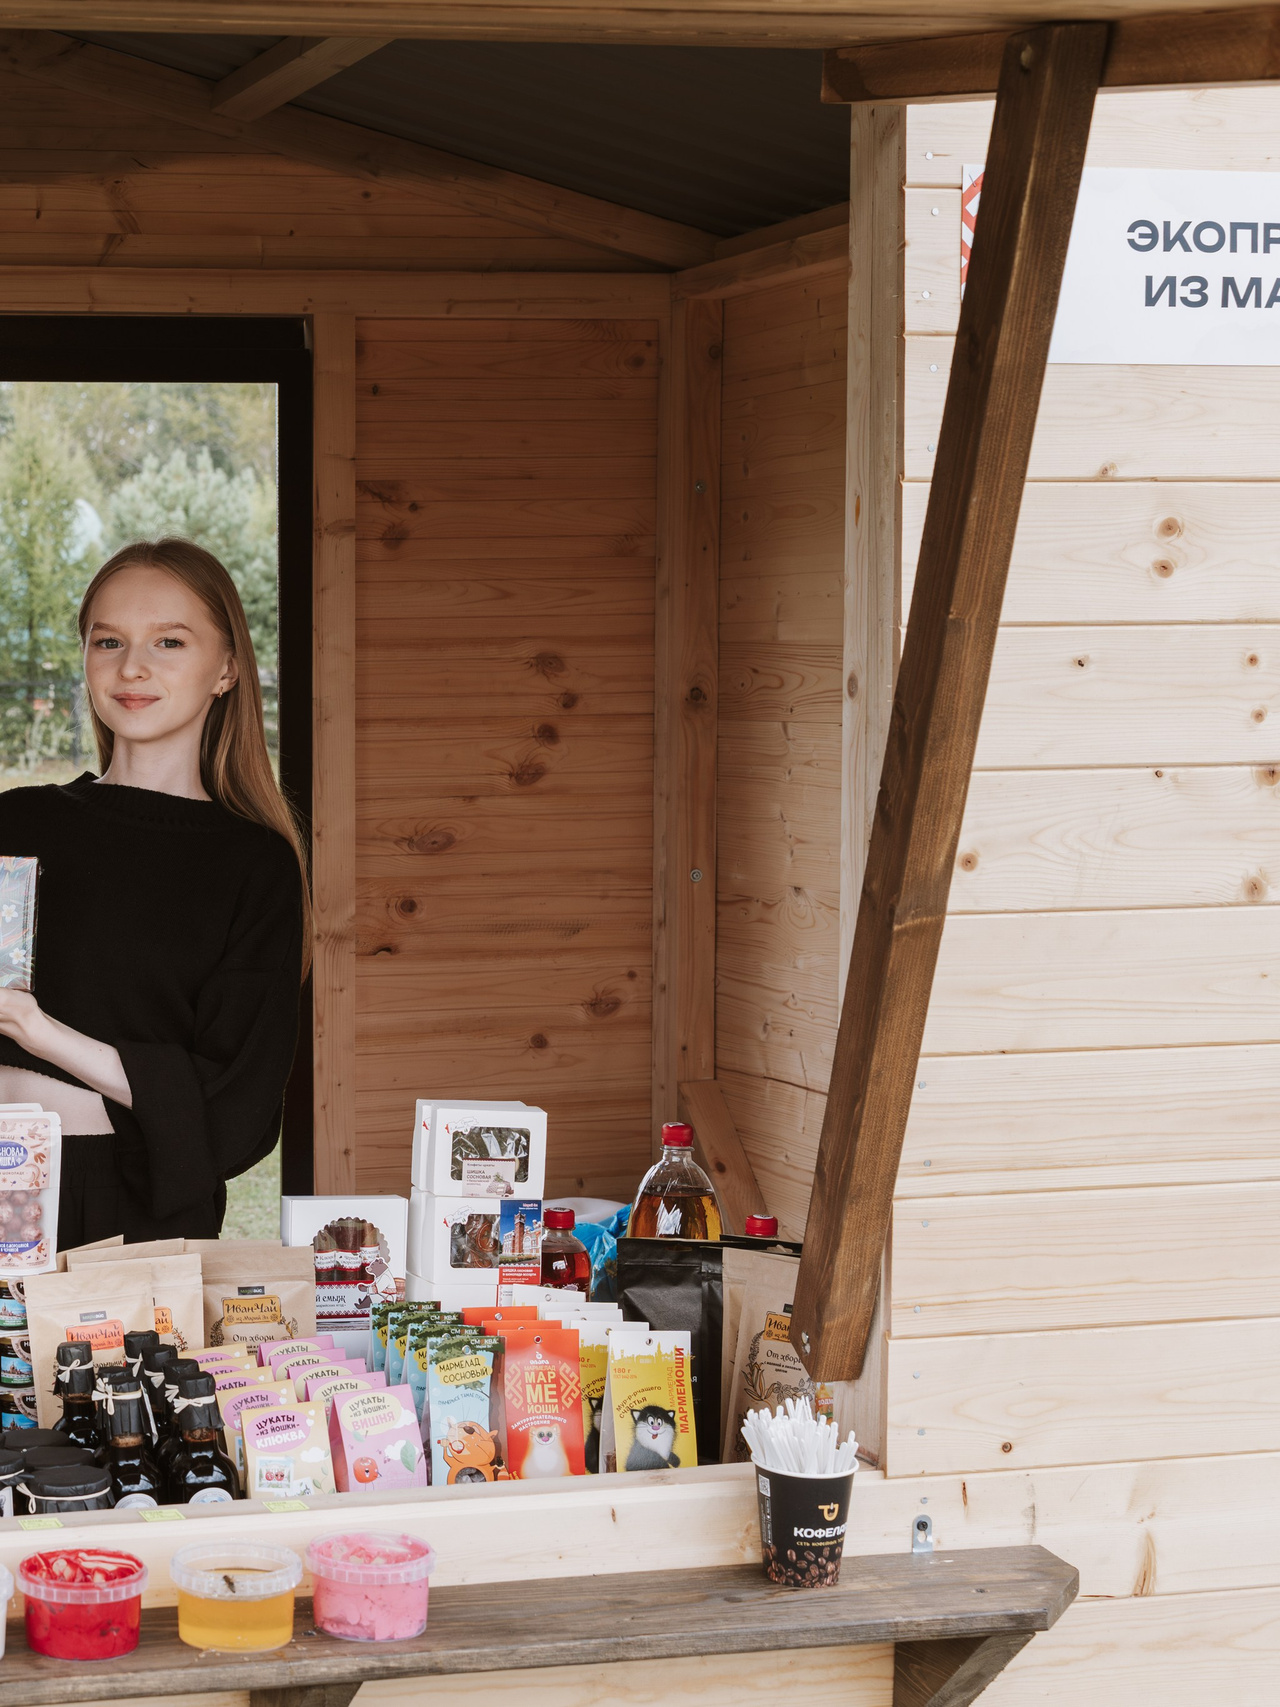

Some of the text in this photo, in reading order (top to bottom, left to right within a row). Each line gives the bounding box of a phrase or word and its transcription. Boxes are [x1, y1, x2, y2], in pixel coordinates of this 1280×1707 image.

[1127, 220, 1280, 254] ЭКОПР
[1144, 275, 1209, 308] ИЗ
[225, 1299, 278, 1313] Иван-Чай
[232, 1334, 275, 1343] От хвори
[766, 1349, 780, 1359] От
[439, 1357, 481, 1373] МАРМЕЛАД
[443, 1366, 489, 1384] СОСНОВЫЙ
[524, 1371, 556, 1383] МАР
[322, 1382, 358, 1397] ЦУКАТЫ
[526, 1384, 558, 1403] МЕ
[674, 1347, 690, 1434] МАРМЕЙОШИ
[232, 1394, 269, 1411] ЦУКАТЫ
[349, 1396, 385, 1412] ЦУКАТЫ
[527, 1402, 559, 1413] ЙОШИ
[256, 1414, 295, 1430] ЦУКАТЫ
[352, 1411, 395, 1430] ВИШНЯ
[256, 1429, 306, 1448] КЛЮКВА
